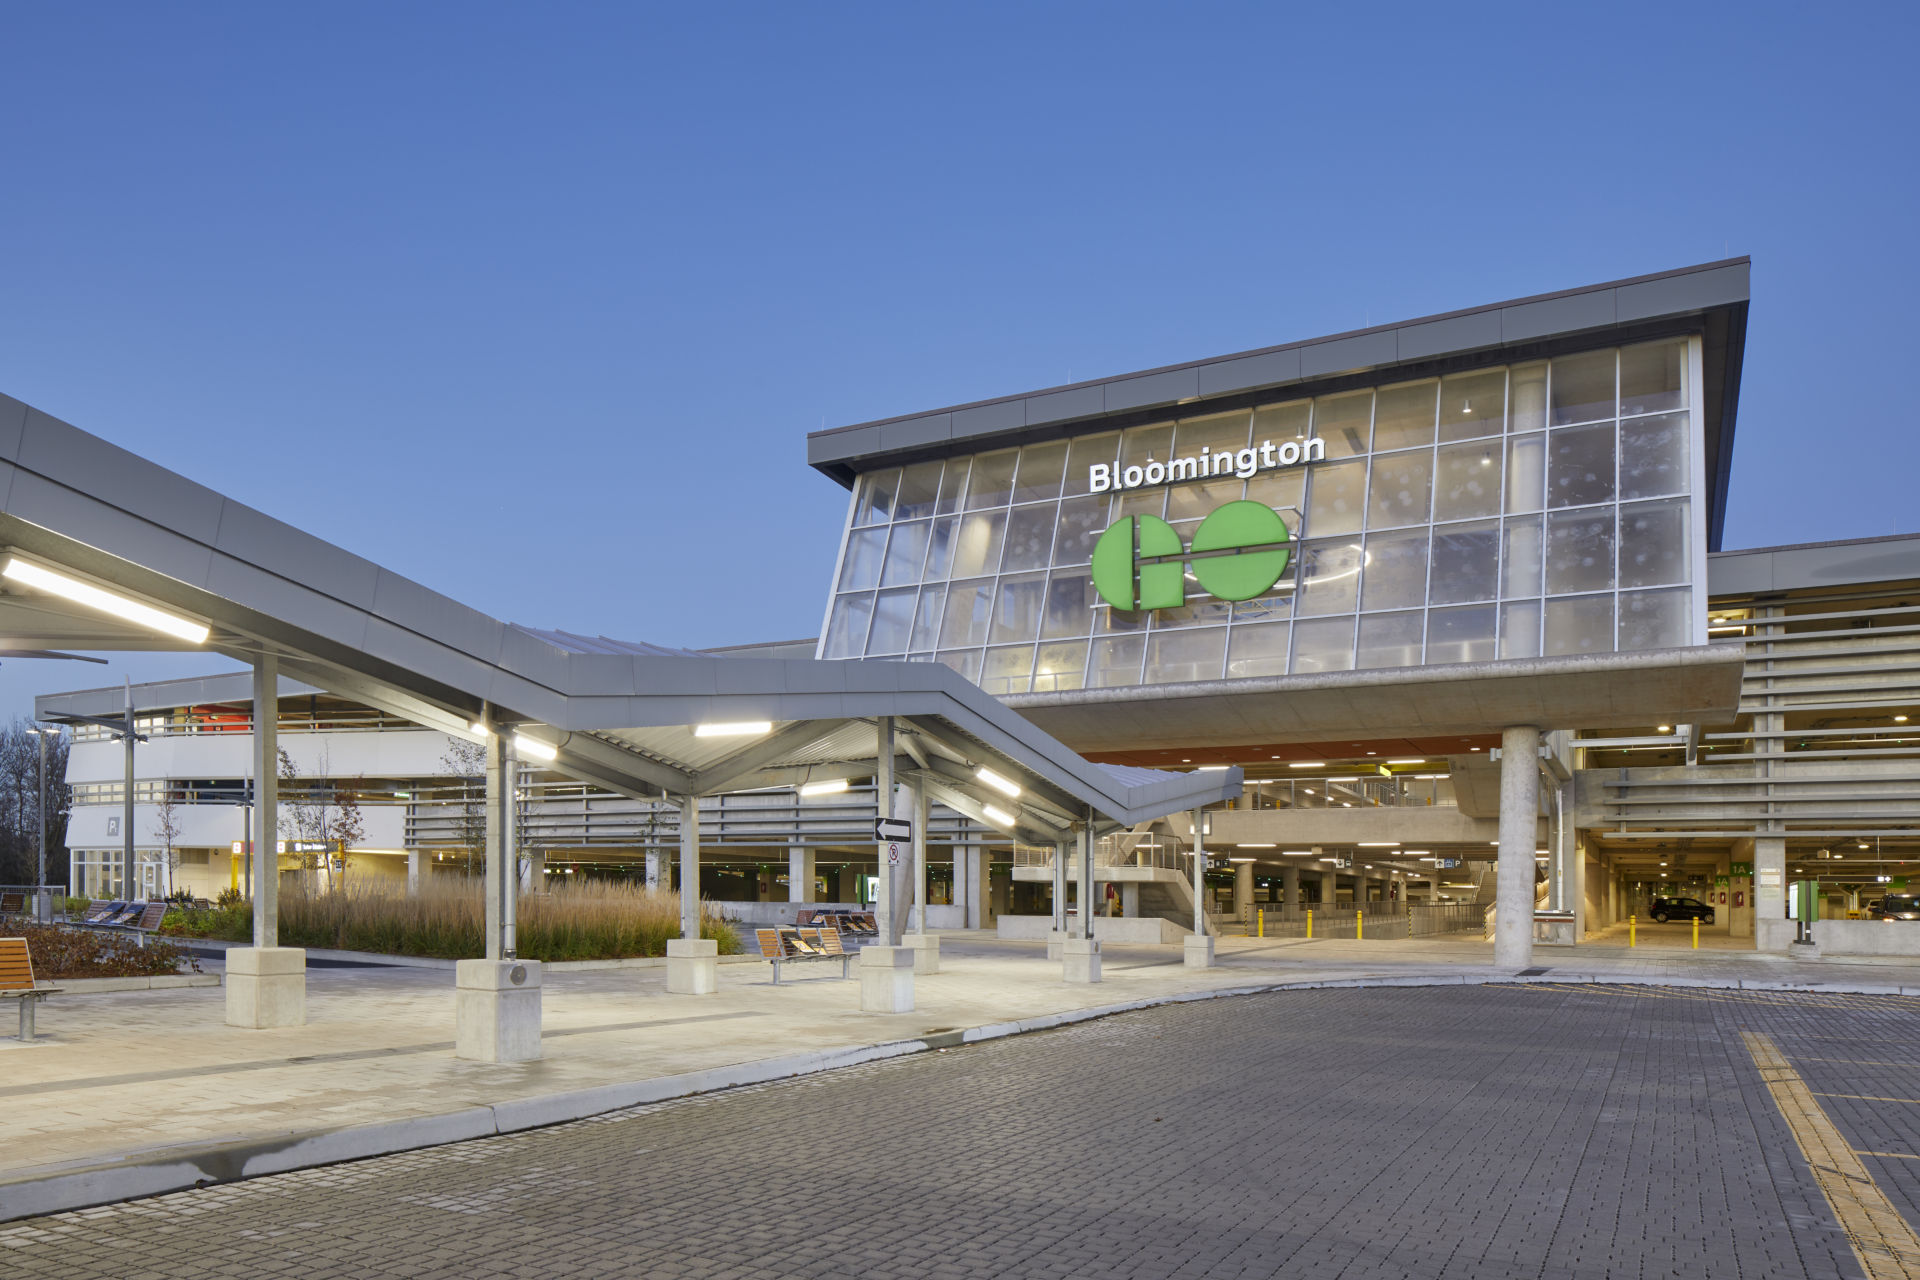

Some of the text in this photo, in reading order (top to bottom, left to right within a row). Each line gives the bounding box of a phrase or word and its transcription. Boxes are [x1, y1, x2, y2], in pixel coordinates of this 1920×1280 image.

[1089, 437, 1325, 493] Bloomington
[1091, 499, 1291, 612] GO
[1733, 865, 1746, 874] 1A
